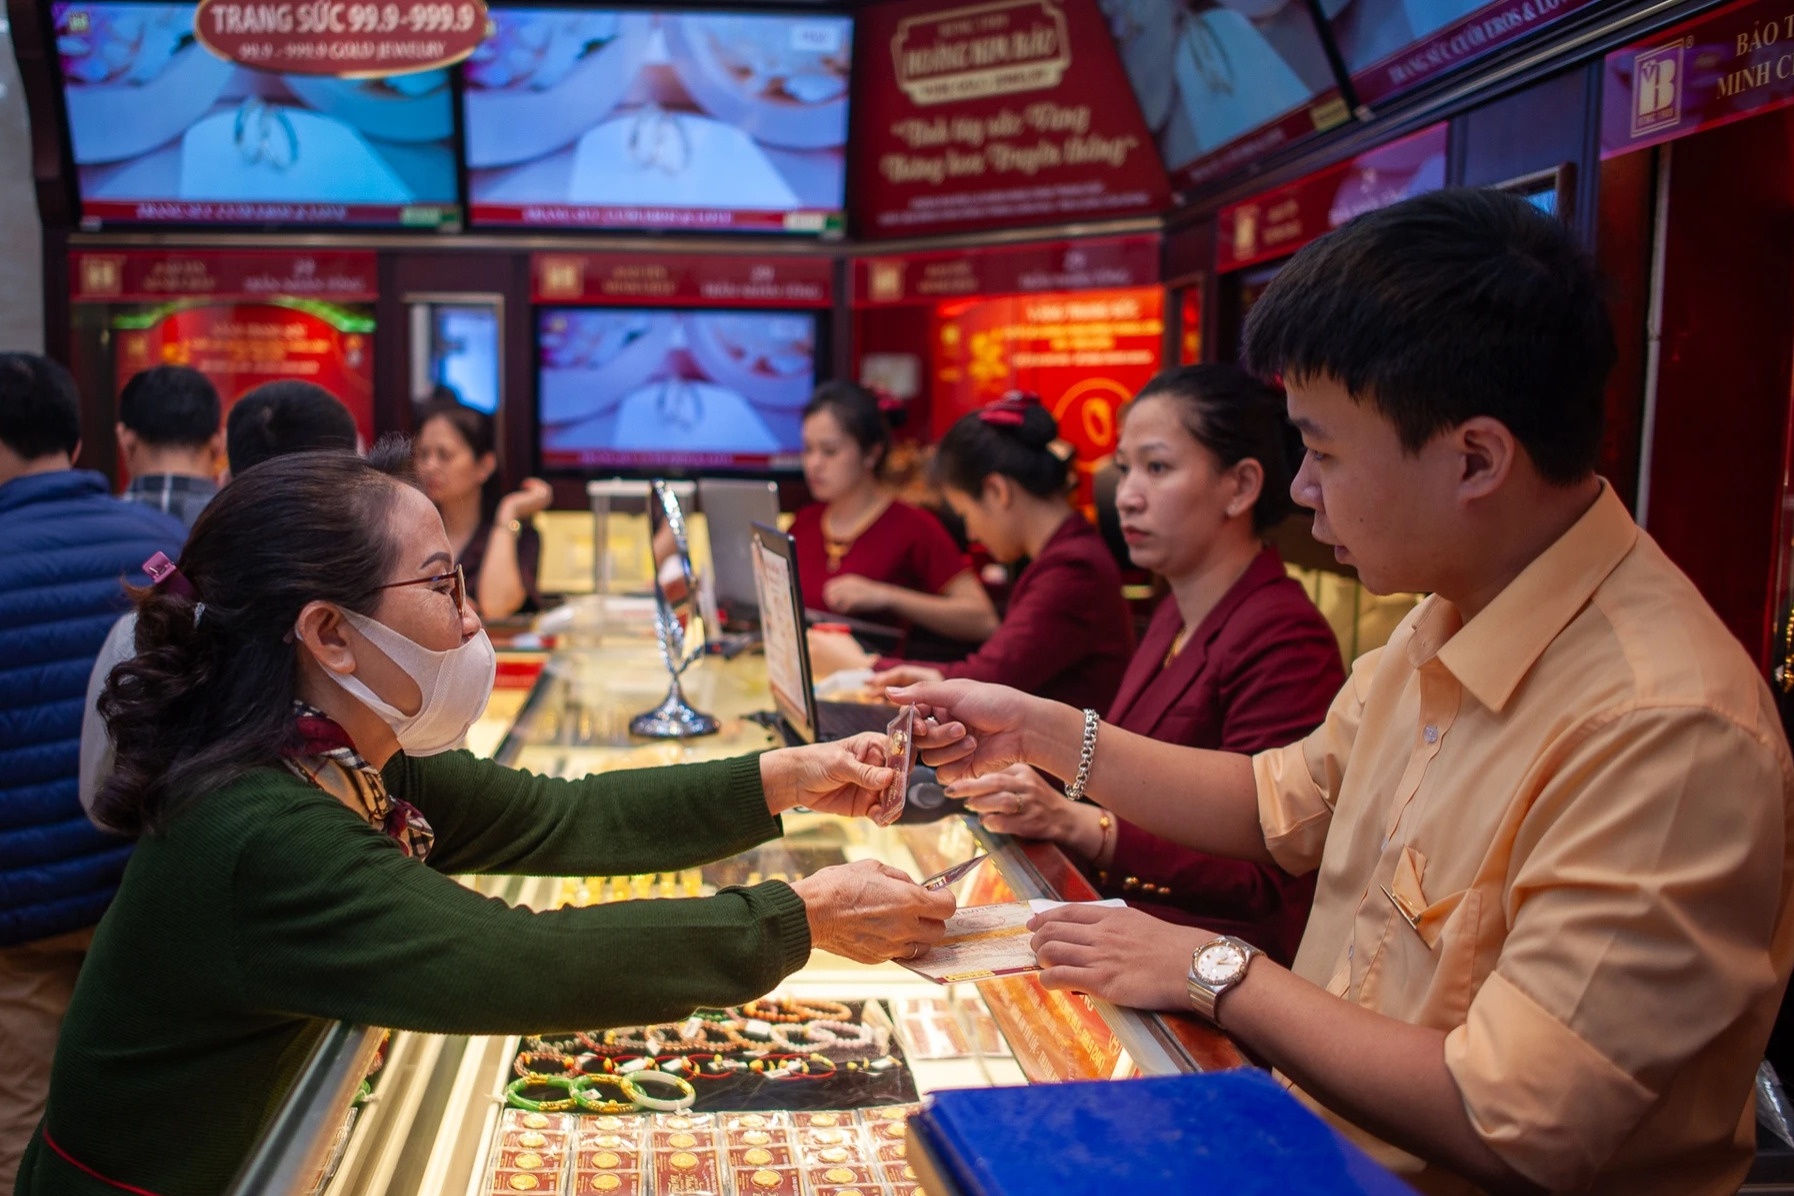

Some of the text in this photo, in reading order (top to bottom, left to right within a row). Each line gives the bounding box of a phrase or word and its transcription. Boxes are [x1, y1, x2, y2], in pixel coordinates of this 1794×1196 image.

[211, 4, 293, 33] TRANG
[1735, 13, 1794, 56] BẢO T
[328, 41, 374, 60] GOLD
[375, 40, 446, 61] JEWELRY
[1716, 60, 1771, 99] MINH
